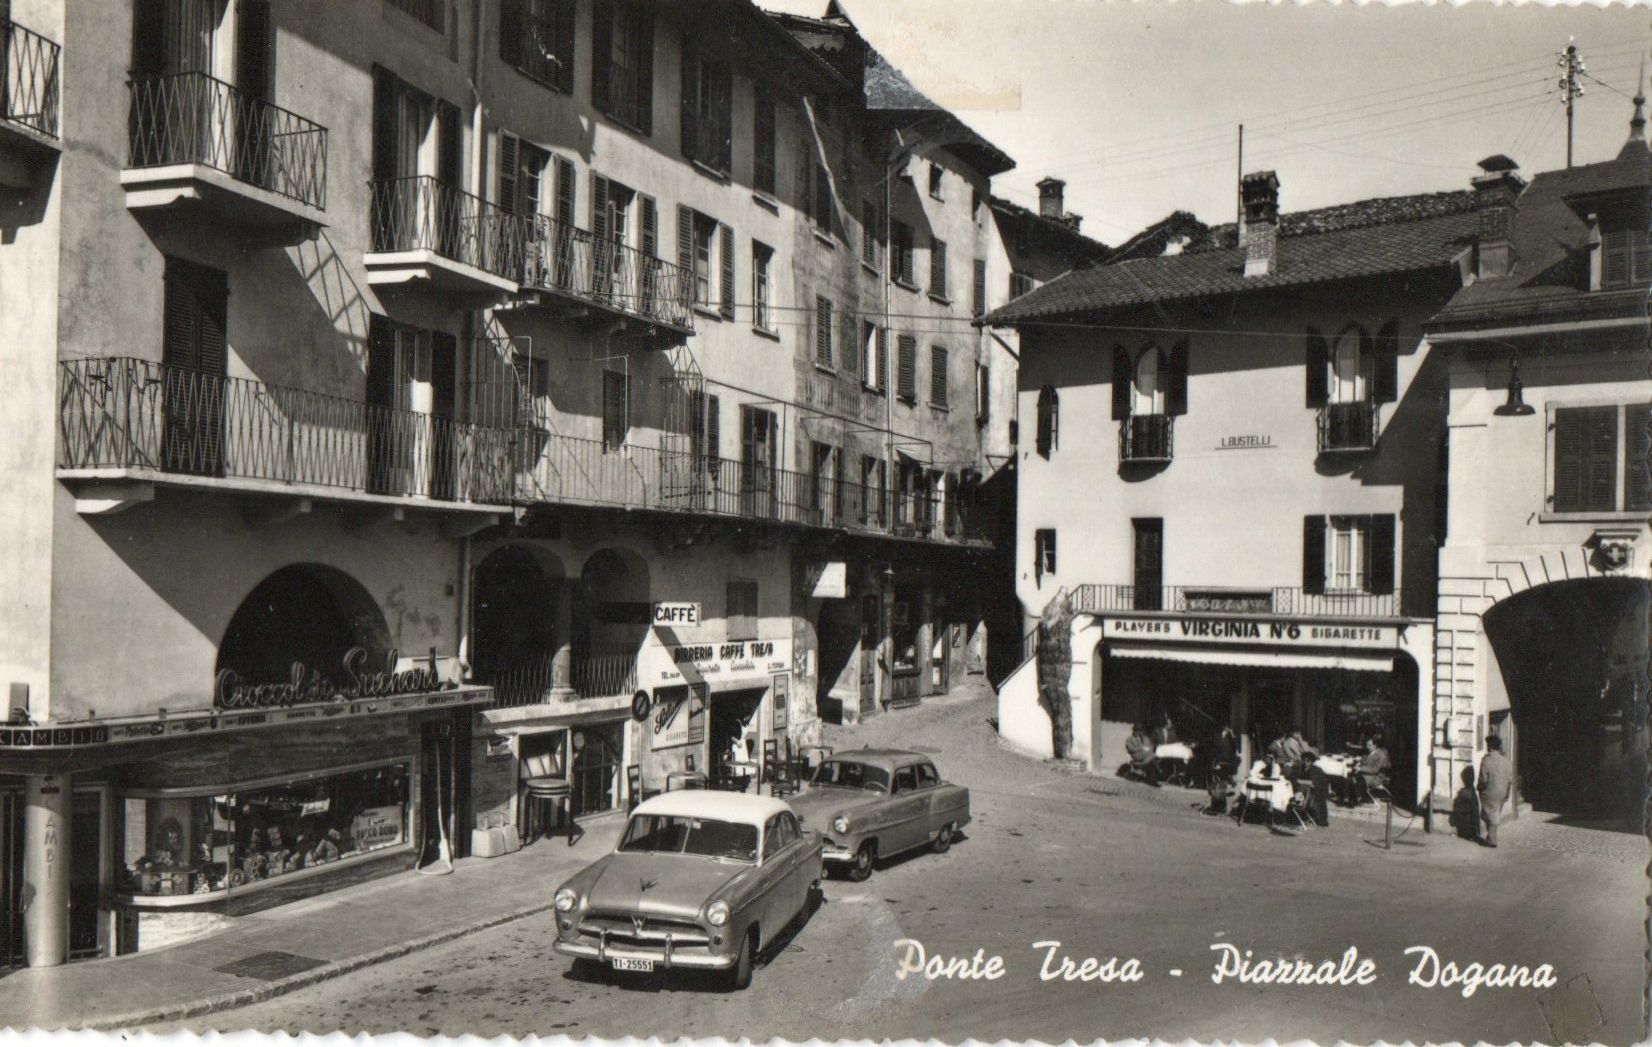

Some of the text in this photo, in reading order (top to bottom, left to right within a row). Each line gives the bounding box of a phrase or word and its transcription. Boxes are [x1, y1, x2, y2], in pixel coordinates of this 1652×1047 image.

[655, 605, 696, 623] CAFFÈ
[1181, 620, 1260, 639] VIRGINIA
[673, 641, 774, 664] BIRRERIA CAFFÈ TRESA
[343, 646, 440, 696] Suchard
